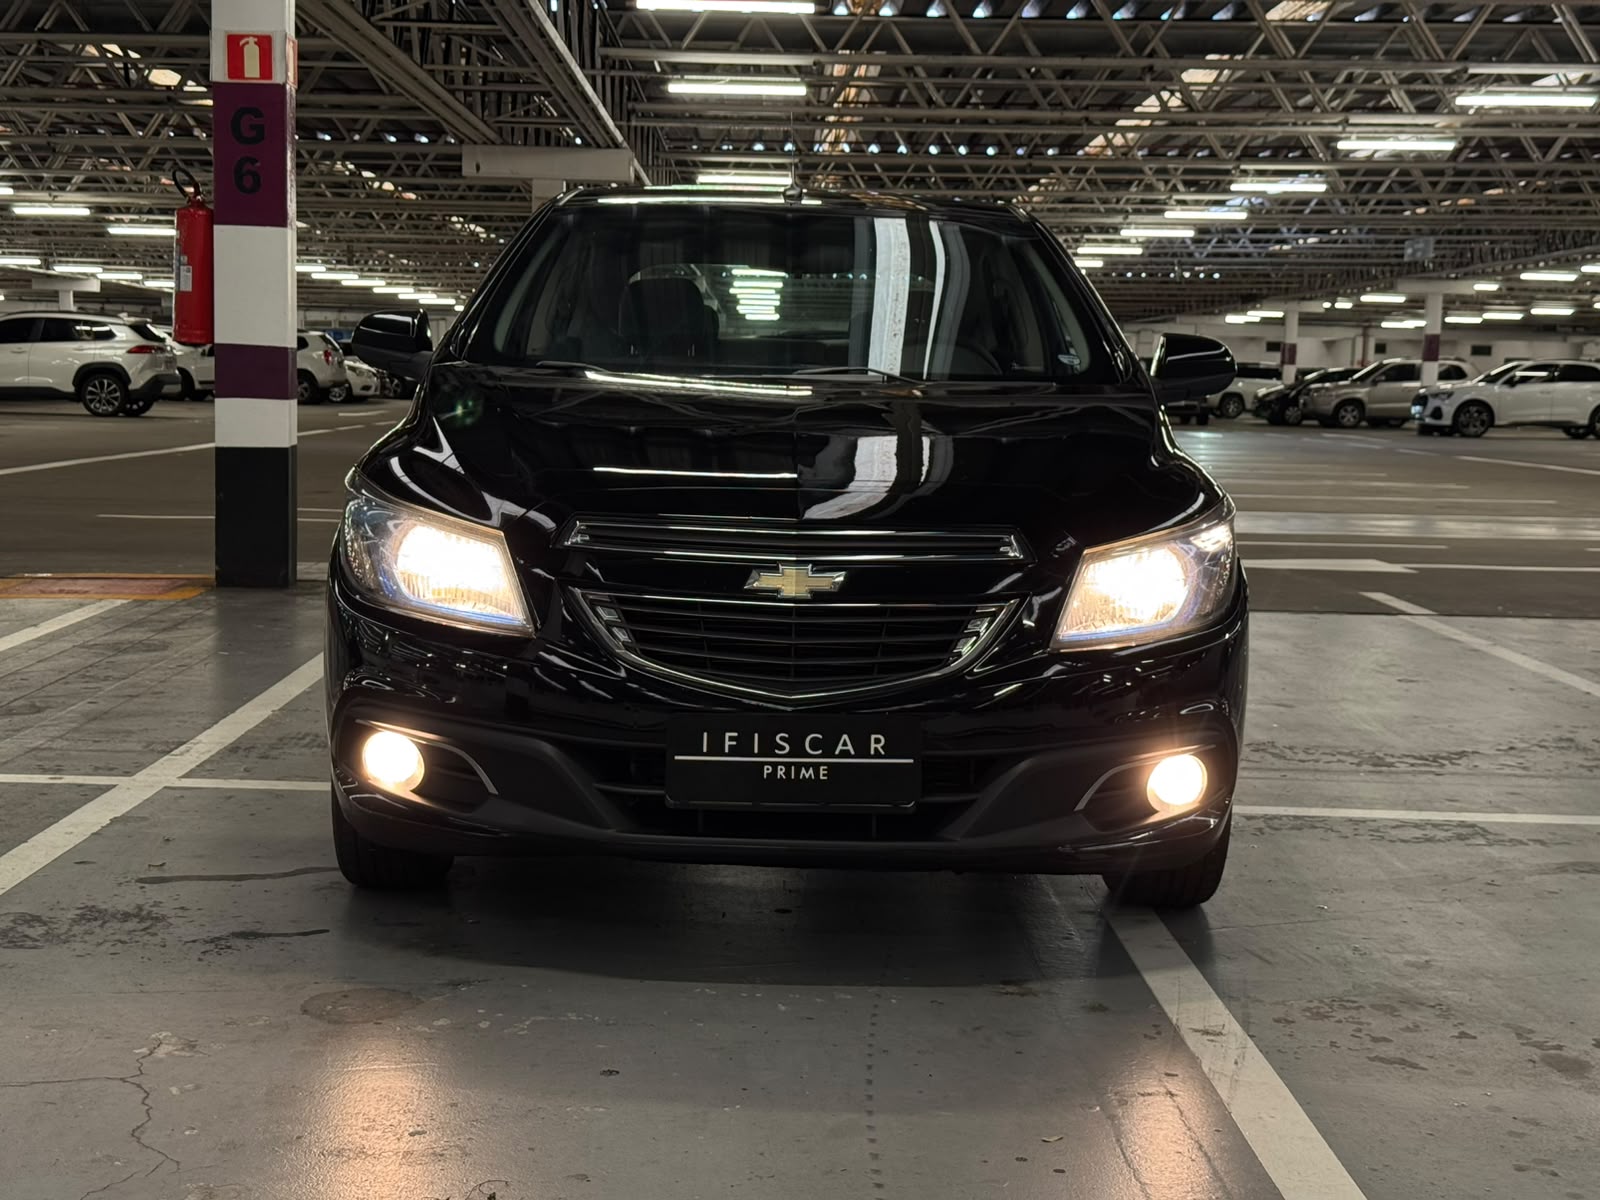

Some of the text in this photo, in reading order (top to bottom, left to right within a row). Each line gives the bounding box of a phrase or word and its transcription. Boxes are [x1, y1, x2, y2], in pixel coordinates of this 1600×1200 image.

[231, 107, 266, 145] G
[233, 156, 262, 195] 6
[702, 731, 886, 756] IFISCAR
[763, 765, 829, 780] PRIME
